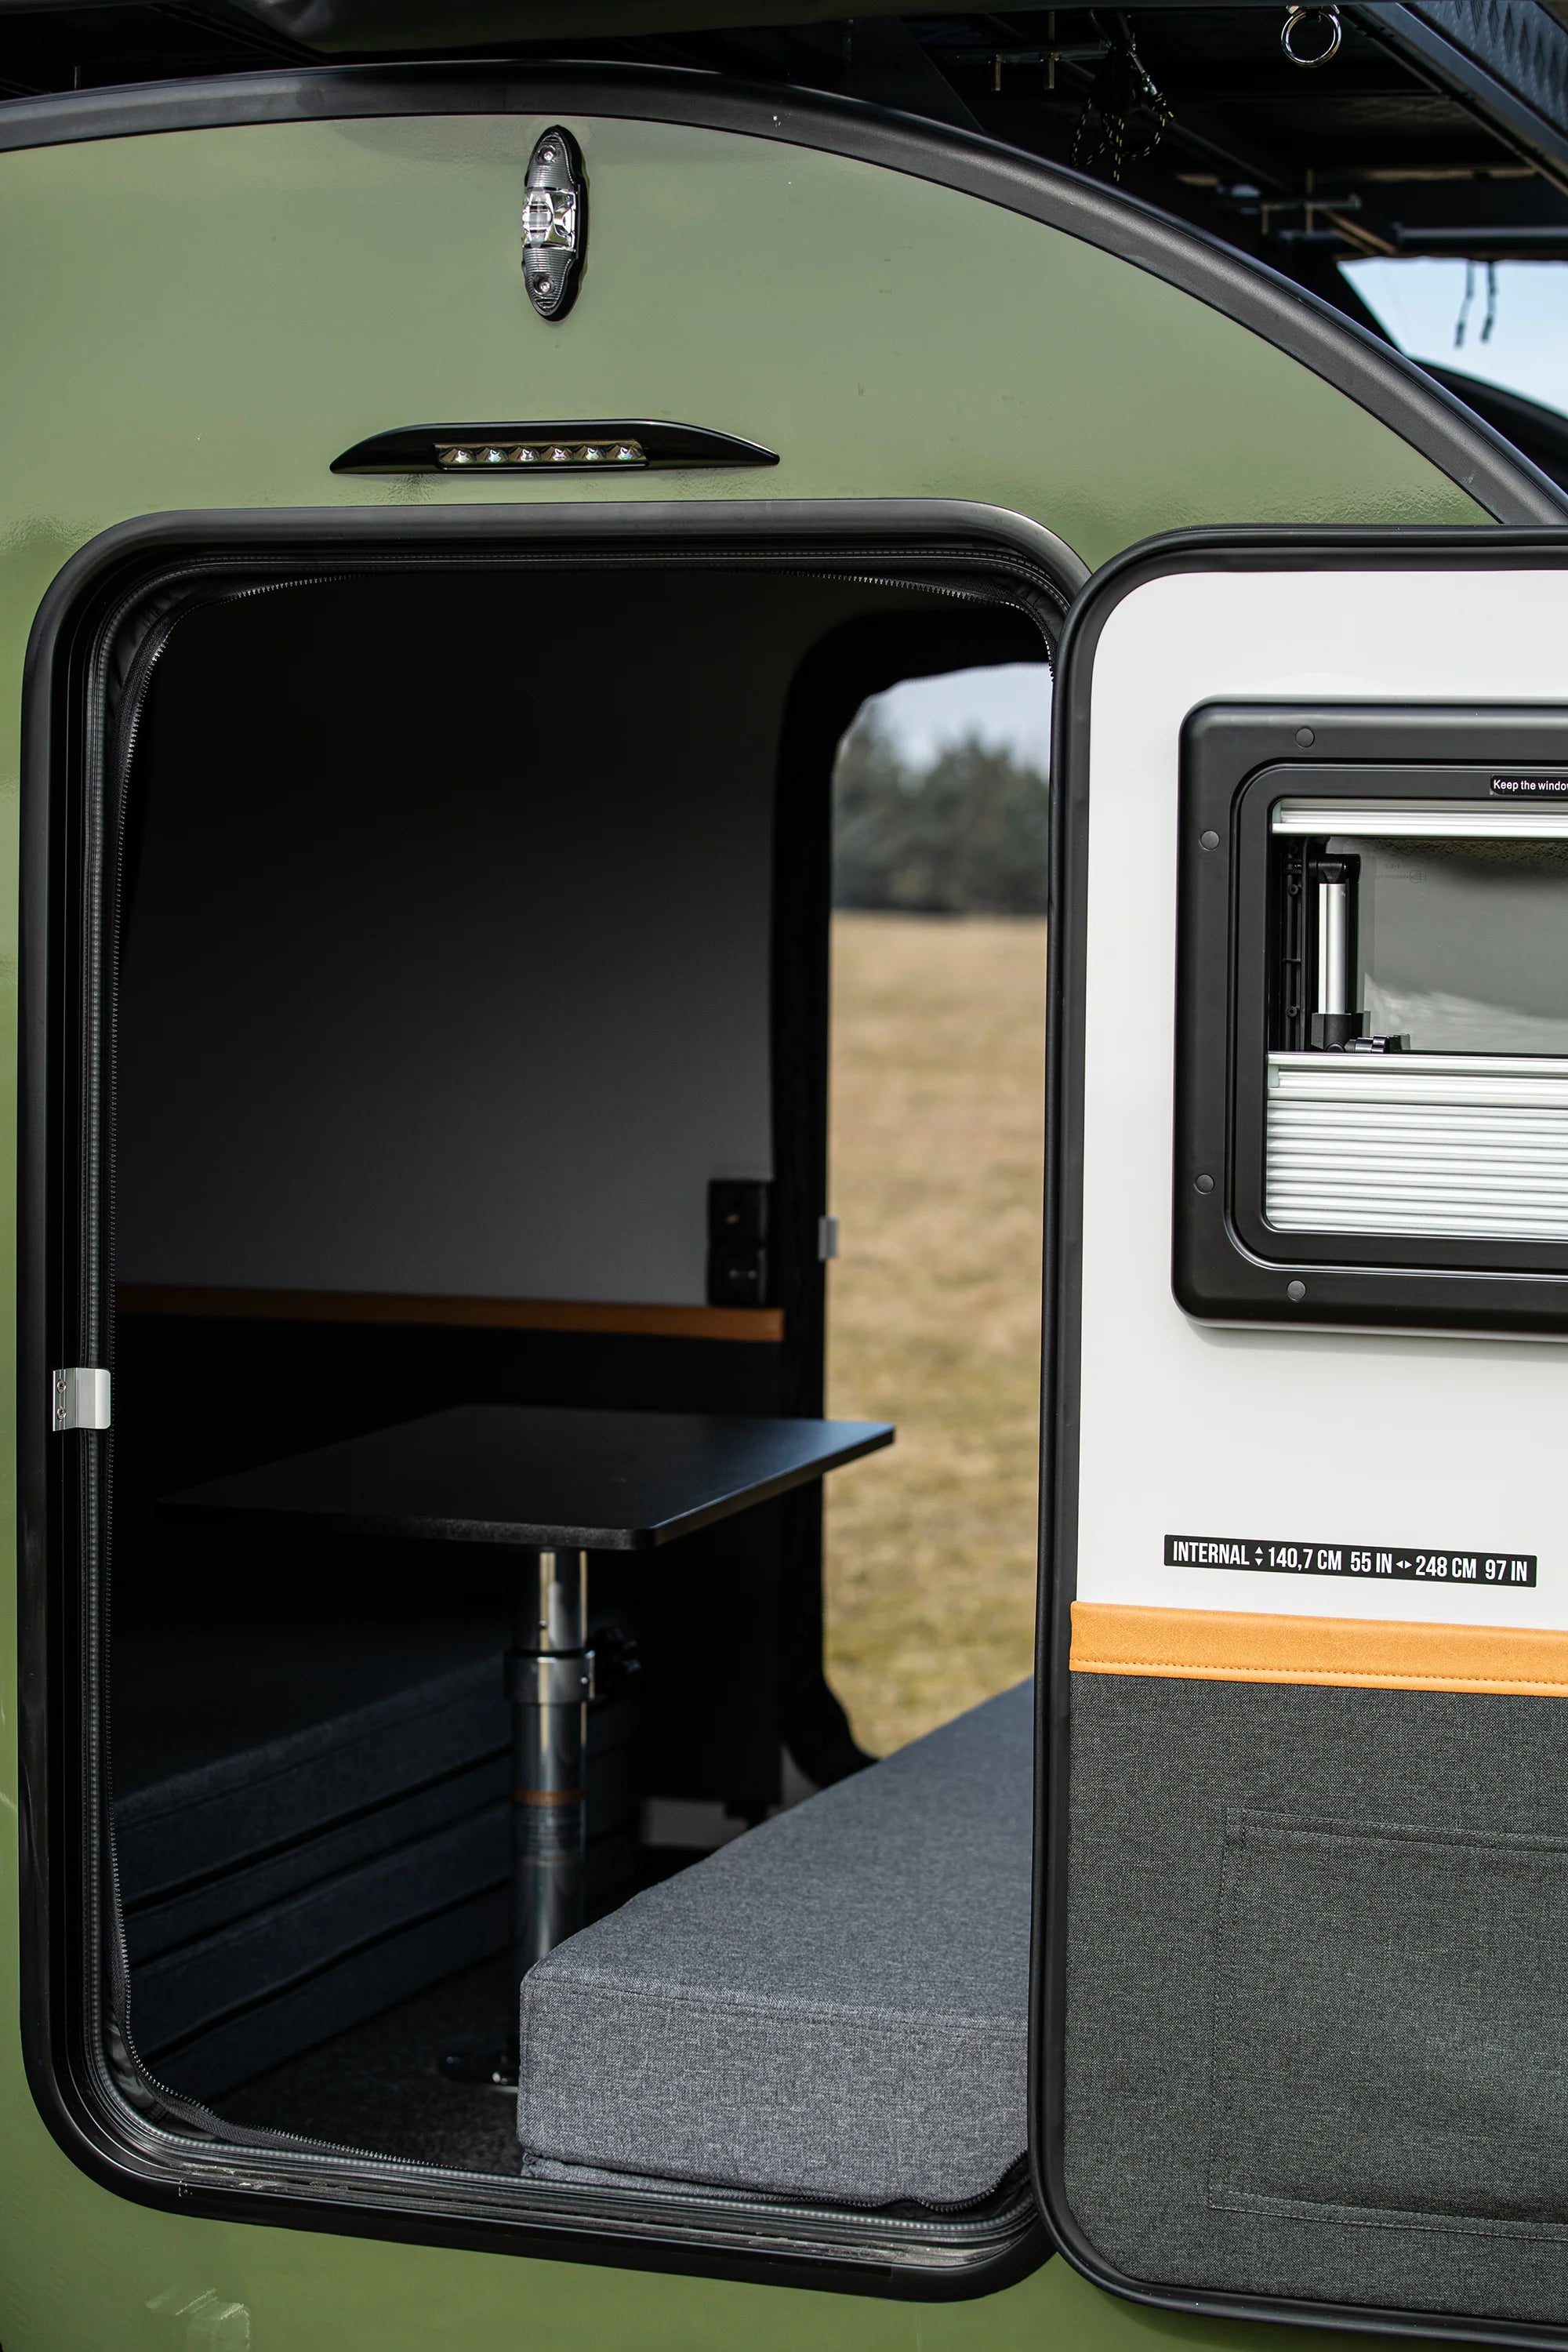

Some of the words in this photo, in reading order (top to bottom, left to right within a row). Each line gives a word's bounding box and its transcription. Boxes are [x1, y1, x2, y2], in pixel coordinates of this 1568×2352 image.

[1494, 779, 1519, 792] Keep
[1521, 780, 1536, 790] the
[1173, 1541, 1250, 1566] INTERNAL
[1268, 1546, 1313, 1571] 140,7
[1317, 1549, 1342, 1571] CM
[1350, 1551, 1372, 1573] 55
[1375, 1552, 1392, 1574] IN
[1415, 1555, 1448, 1577] 248
[1451, 1557, 1477, 1579] CM
[1485, 1559, 1507, 1581] 97
[1511, 1560, 1527, 1582] IN
